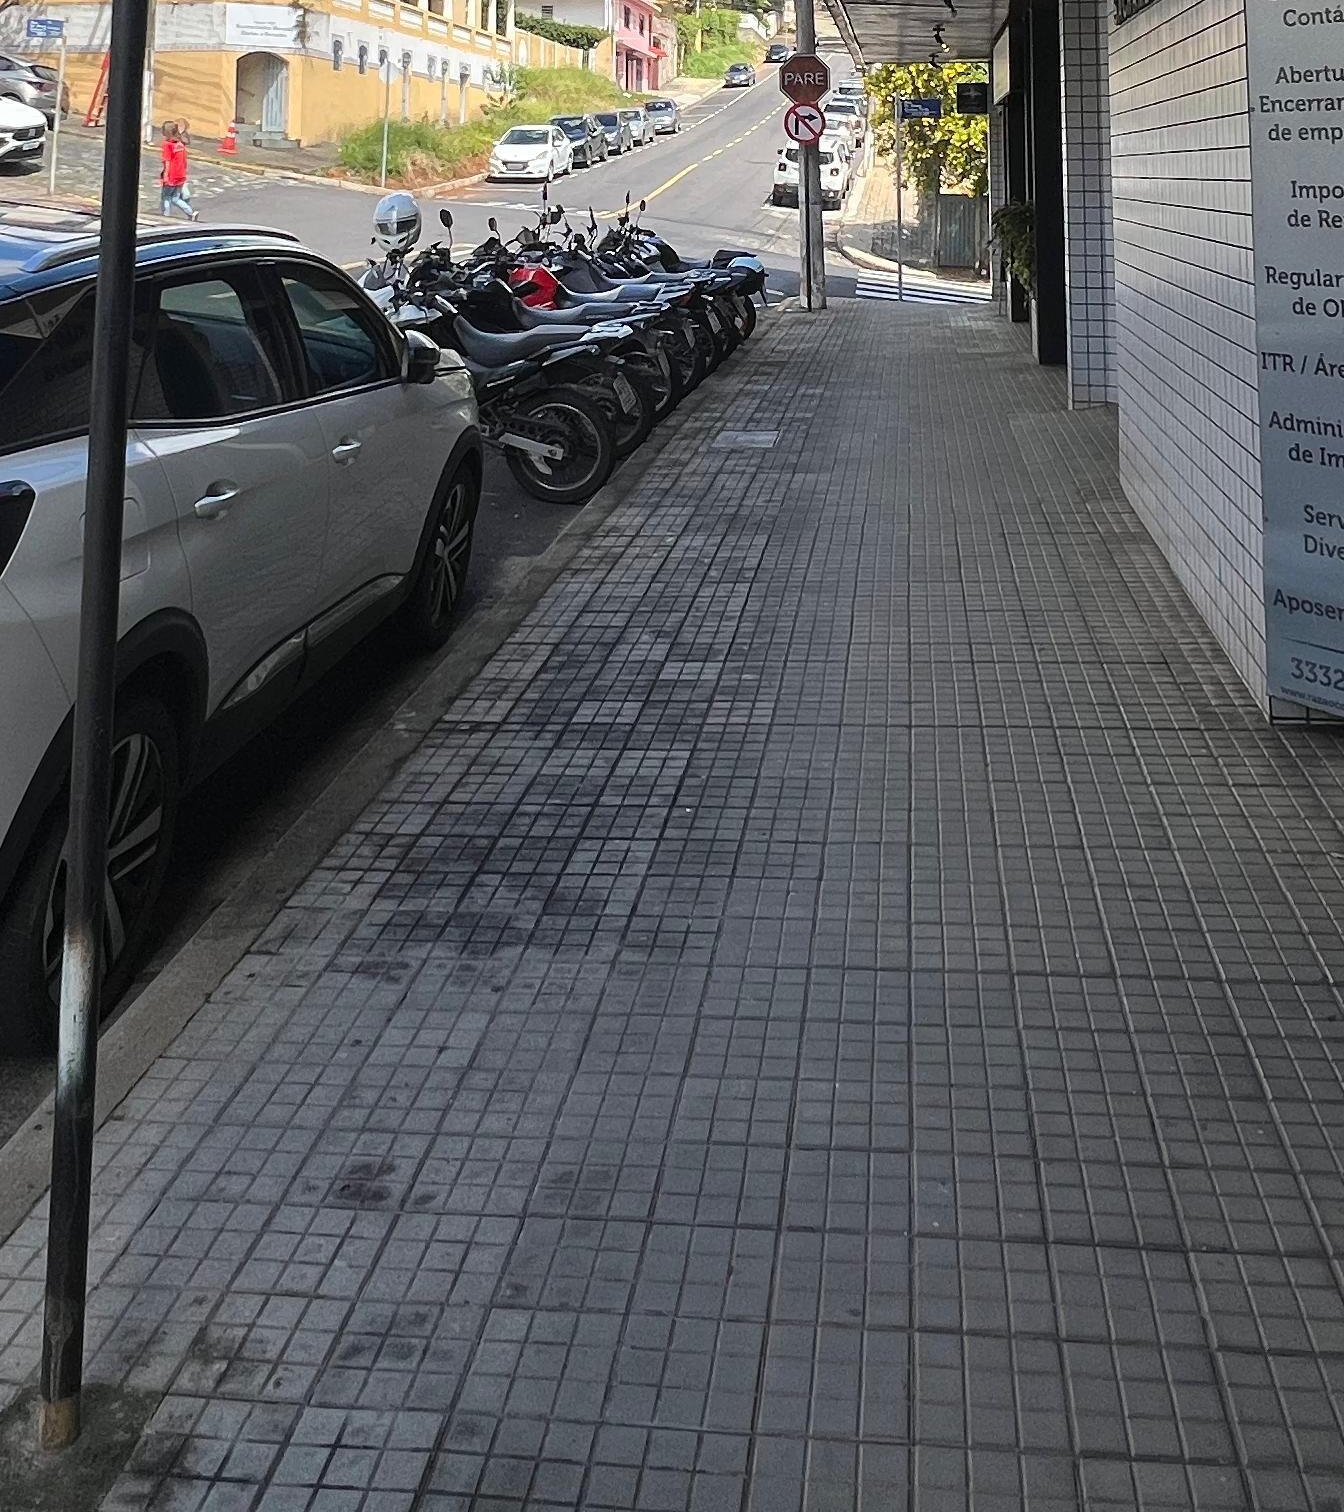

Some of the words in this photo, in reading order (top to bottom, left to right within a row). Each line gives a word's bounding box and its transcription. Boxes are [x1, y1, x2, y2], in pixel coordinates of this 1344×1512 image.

[784, 72, 825, 86] PARE
[1268, 124, 1292, 141] de
[1287, 210, 1312, 229] de
[1292, 297, 1318, 317] de
[1261, 351, 1294, 374] ITR
[1288, 443, 1313, 464] de
